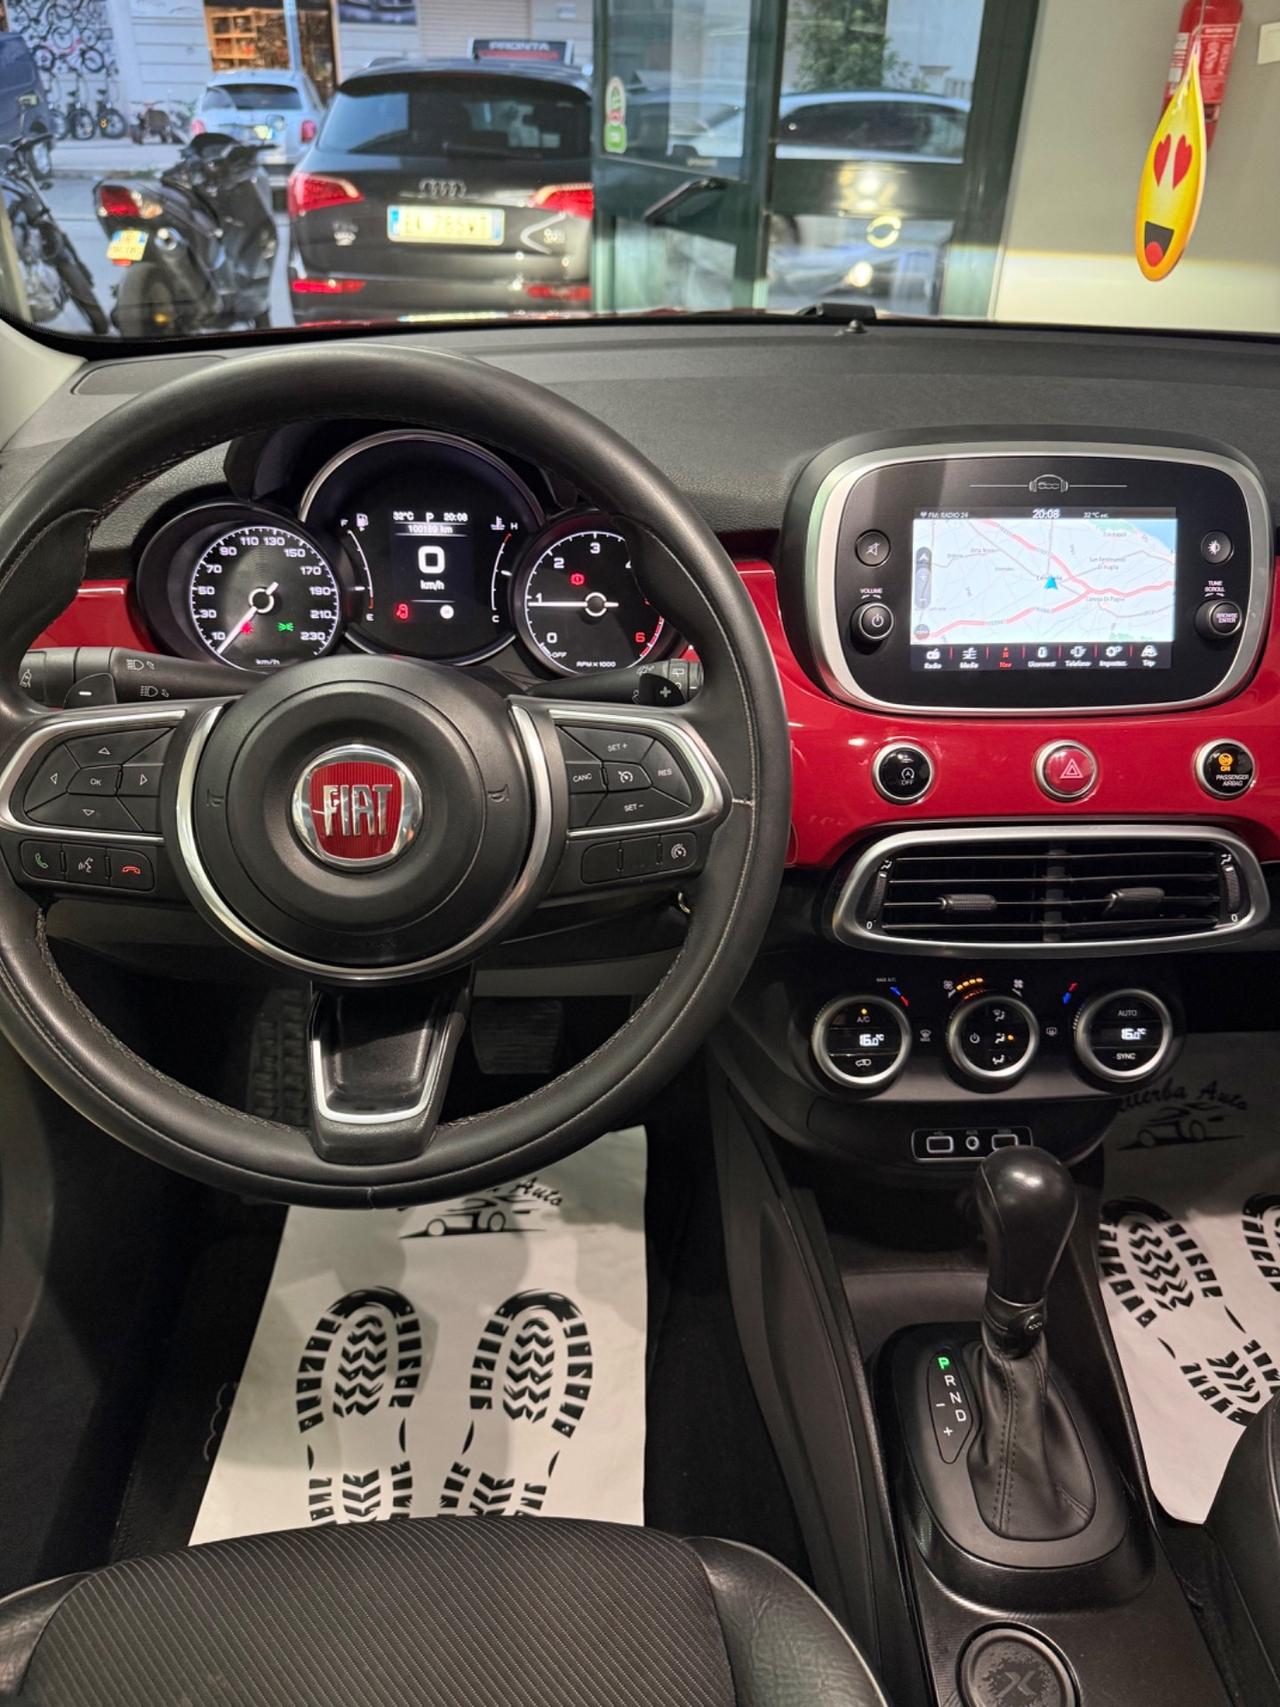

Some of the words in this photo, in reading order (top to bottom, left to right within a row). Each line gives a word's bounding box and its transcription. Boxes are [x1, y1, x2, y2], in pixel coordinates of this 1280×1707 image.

[1032, 508, 1060, 519] 20:08
[340, 519, 348, 527] F
[511, 522, 518, 530] H
[240, 537, 259, 546] 110
[264, 537, 285, 546] 130
[219, 547, 237, 556] 90
[590, 542, 600, 553] 3
[284, 549, 306, 558] 150
[418, 545, 445, 574] 0
[553, 558, 564, 569] 2
[206, 565, 222, 574] 70
[300, 566, 322, 575] 170
[420, 580, 445, 590] km/h
[198, 586, 215, 595] 50
[309, 587, 331, 596] 190
[535, 592, 542, 603] 1
[200, 609, 217, 618] 30
[310, 610, 332, 619] 210
[491, 615, 499, 623] C
[212, 632, 226, 640] 10
[301, 631, 325, 641] 230
[546, 632, 557, 643] 0
[635, 632, 646, 642] 6
[608, 744, 621, 752] SET
[658, 768, 673, 777] RES
[90, 778, 102, 786] OK
[572, 773, 592, 783] CANC
[322, 784, 393, 837] FIAT
[624, 804, 637, 812] SET
[1118, 1009, 1138, 1017] AUTO
[1116, 1052, 1136, 1060] SYNC
[937, 1356, 950, 1370] P
[944, 1374, 956, 1387] R
[949, 1391, 962, 1404] N
[955, 1409, 967, 1422] D
